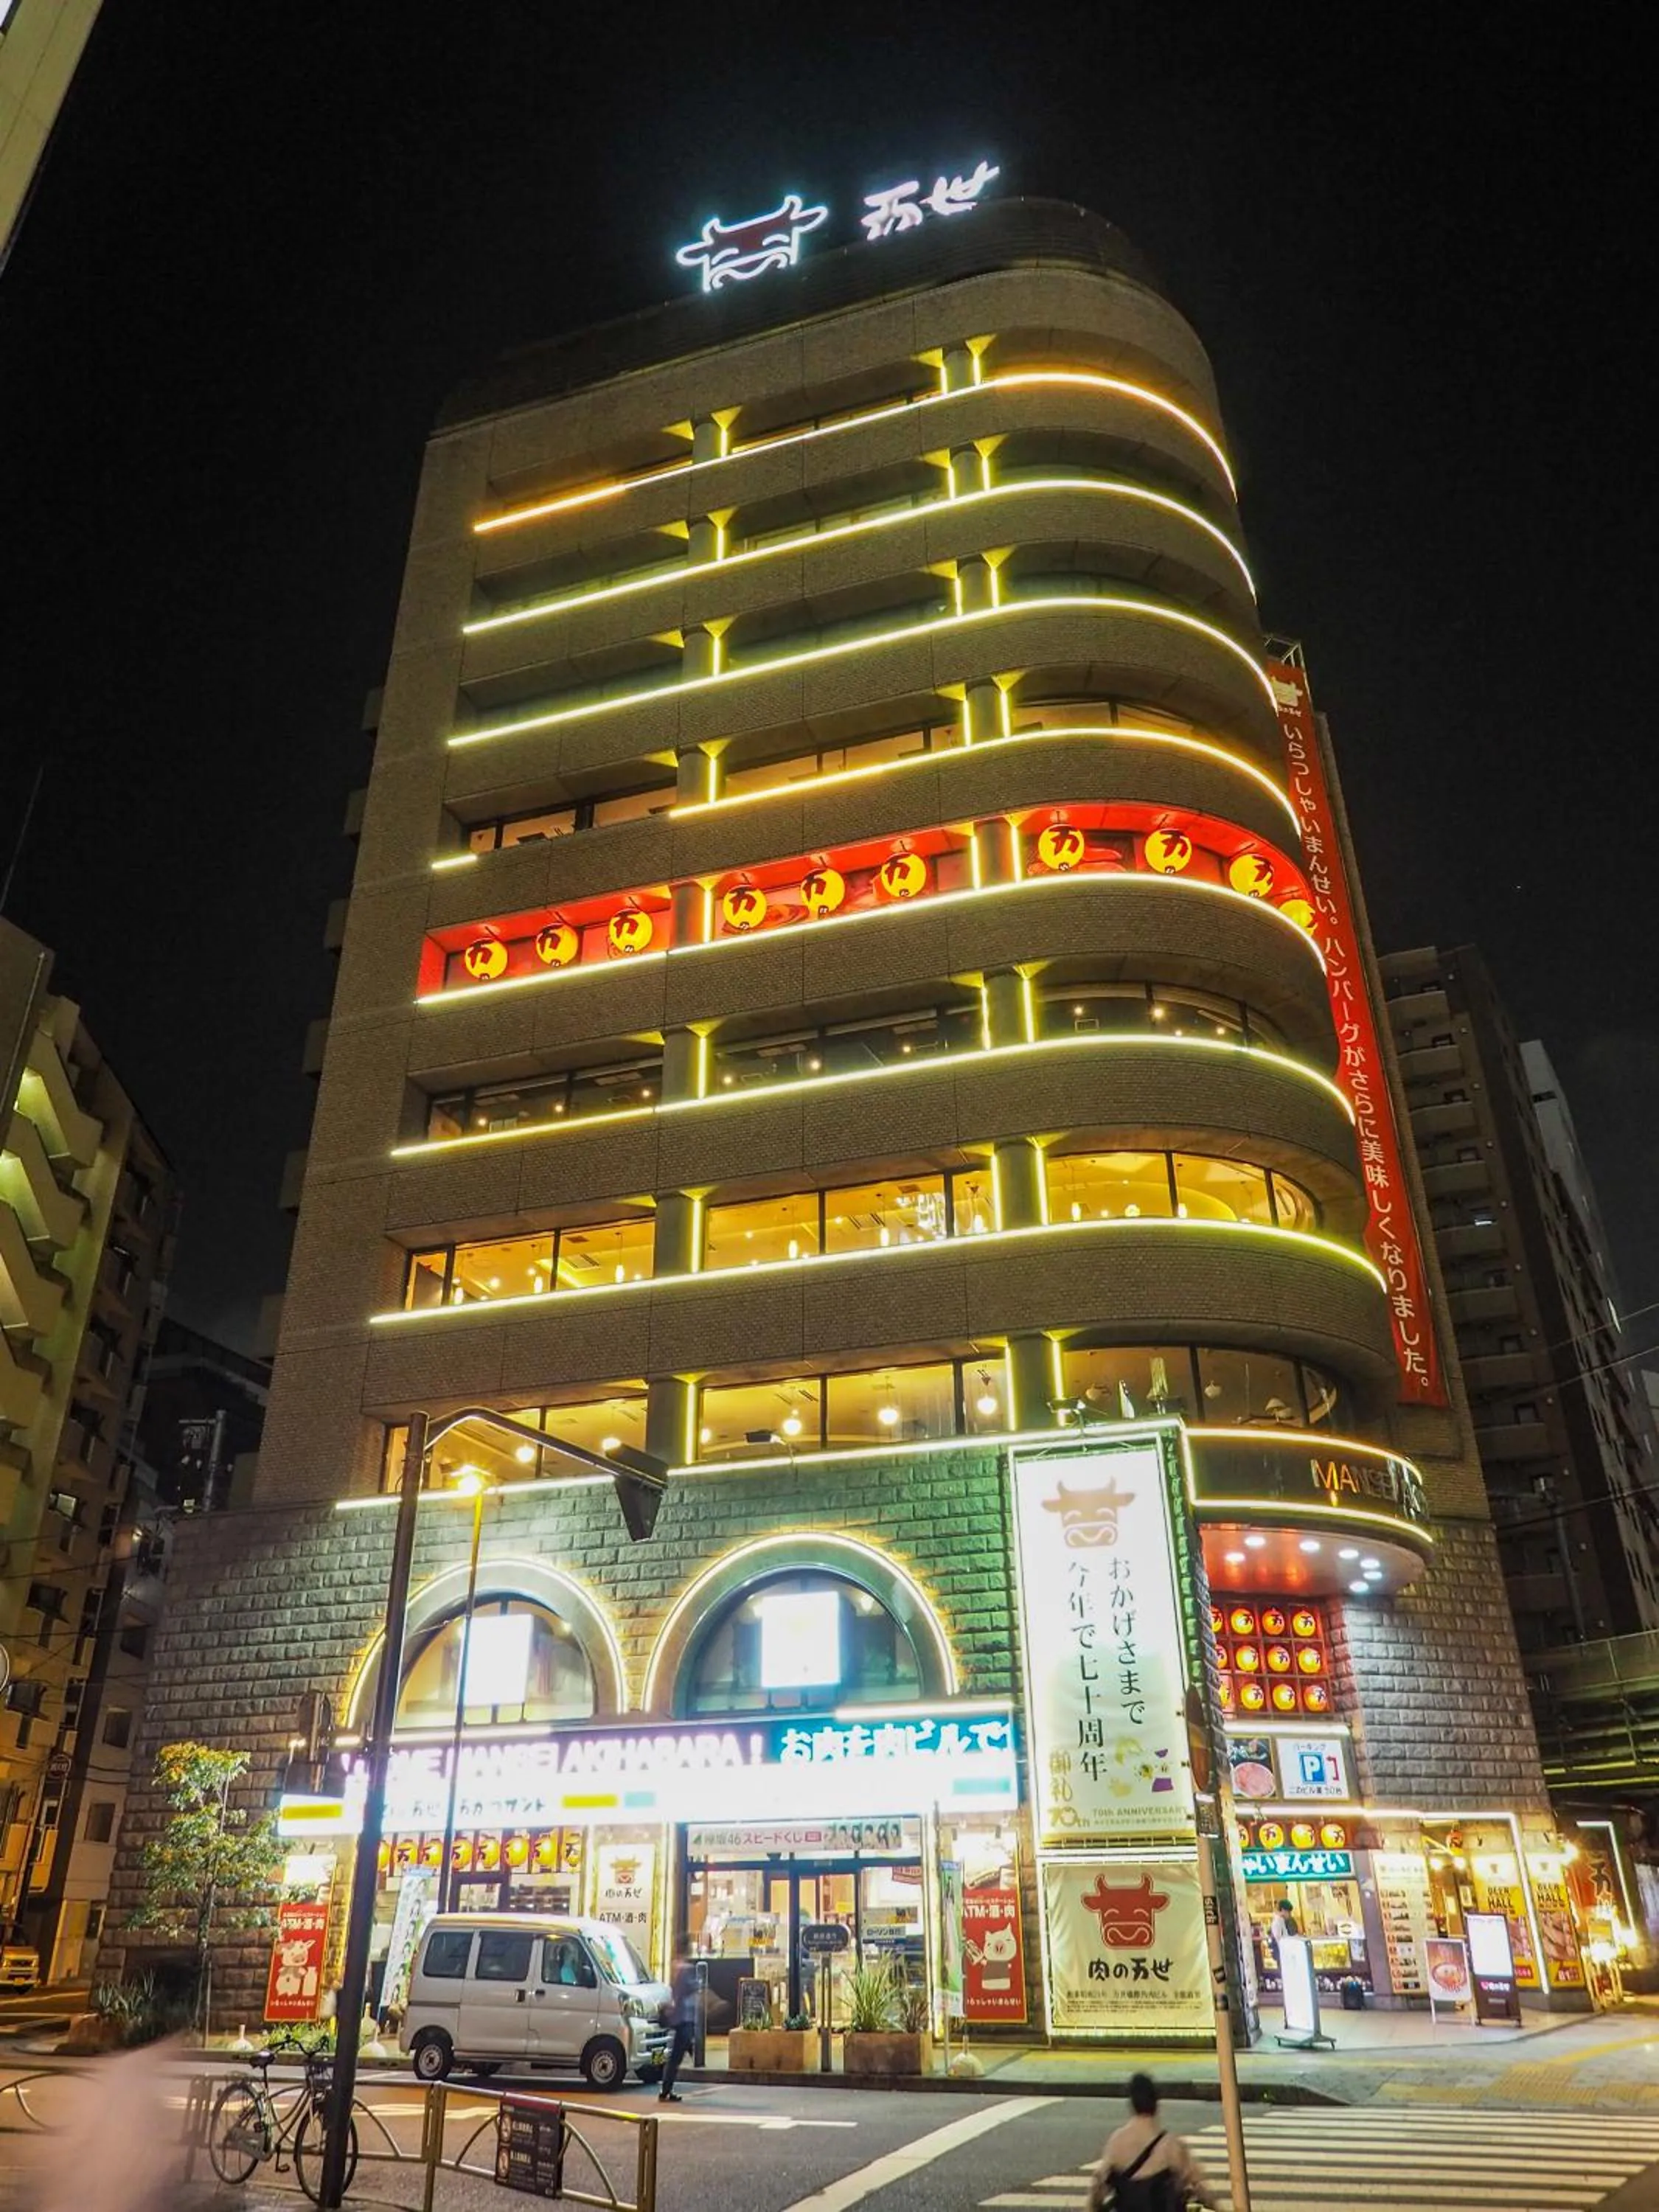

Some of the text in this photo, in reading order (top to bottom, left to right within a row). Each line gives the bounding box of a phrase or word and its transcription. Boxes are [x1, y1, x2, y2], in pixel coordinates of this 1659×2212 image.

[1108, 1557, 1145, 1724] おかげさまで
[1303, 1756, 1321, 1781] P
[1088, 1958, 1174, 1982] 肉の万世
